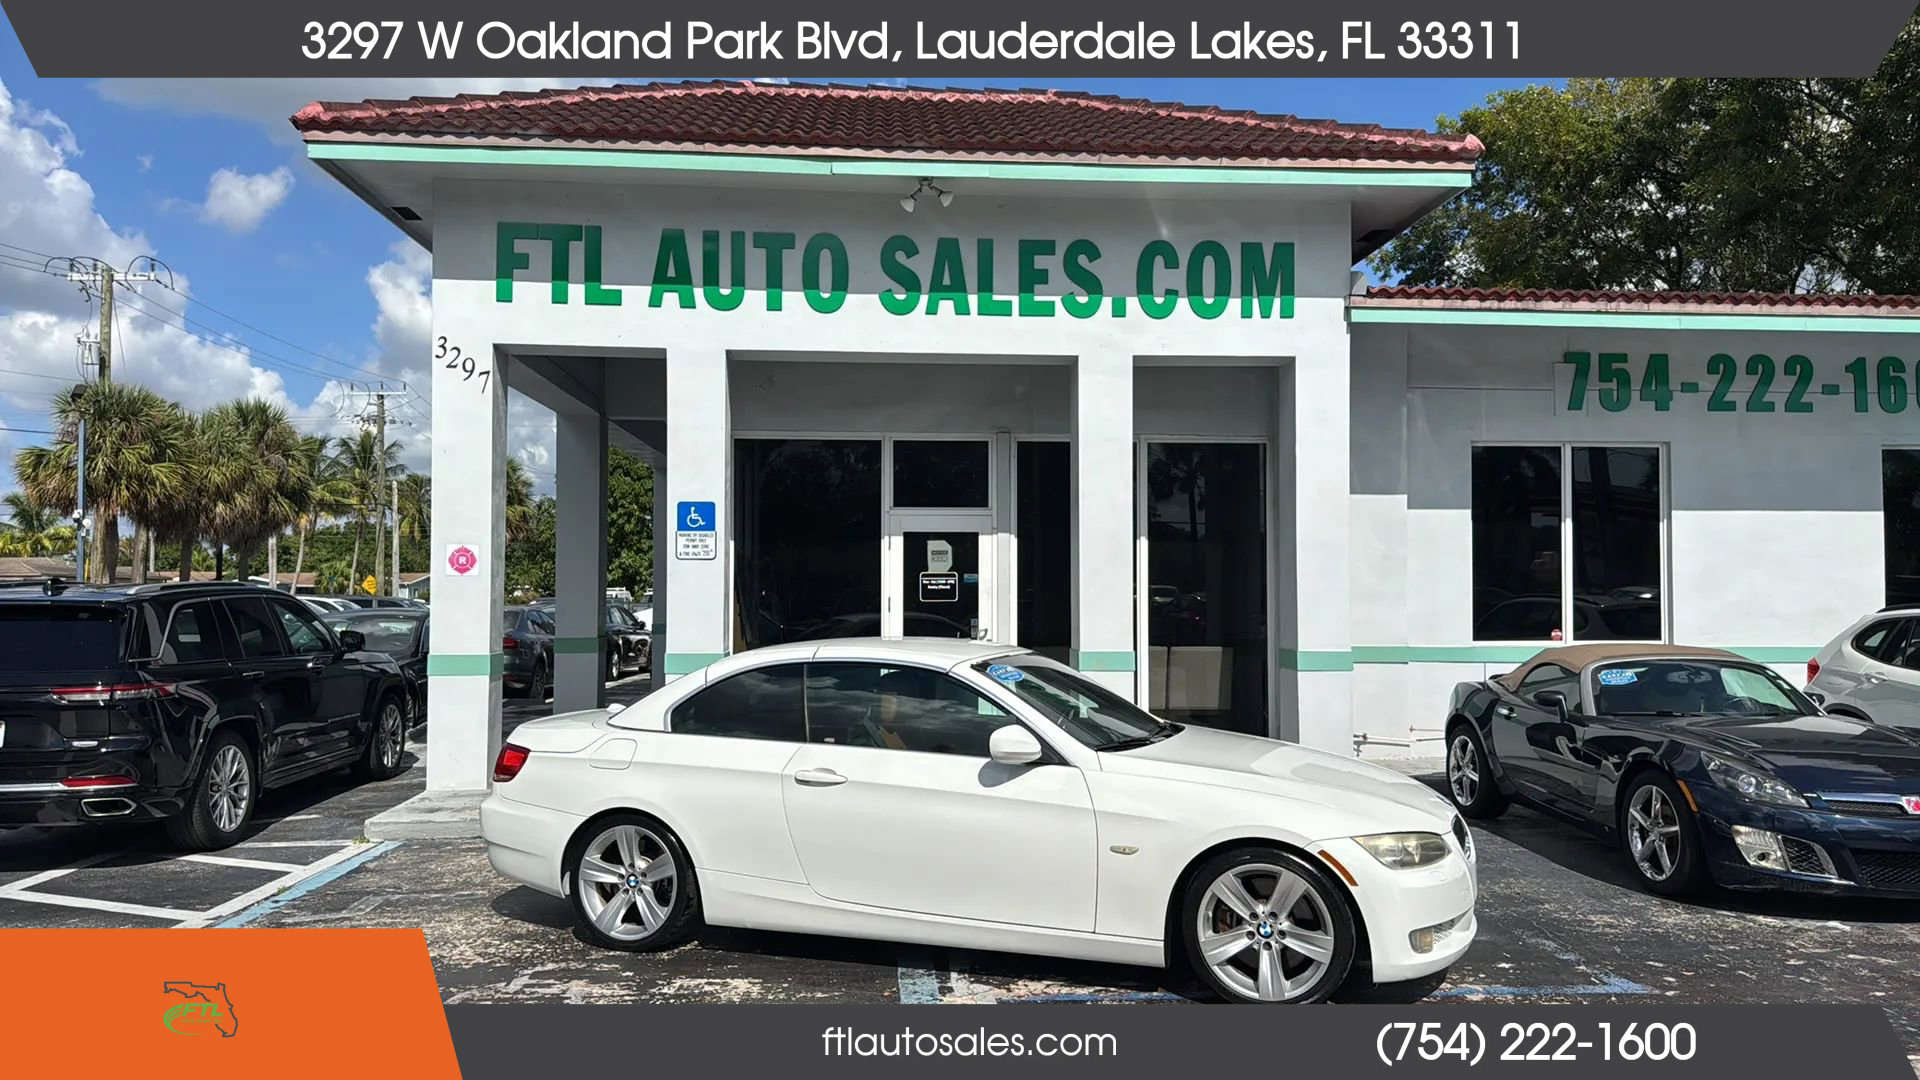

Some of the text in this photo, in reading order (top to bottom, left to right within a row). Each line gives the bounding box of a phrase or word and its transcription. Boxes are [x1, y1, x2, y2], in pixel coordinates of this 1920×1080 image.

[496, 221, 1296, 320] FTL AUTO SALES.COM
[435, 335, 491, 395] 3297
[1563, 350, 1920, 414] 754-222-16
[458, 556, 467, 565] R
